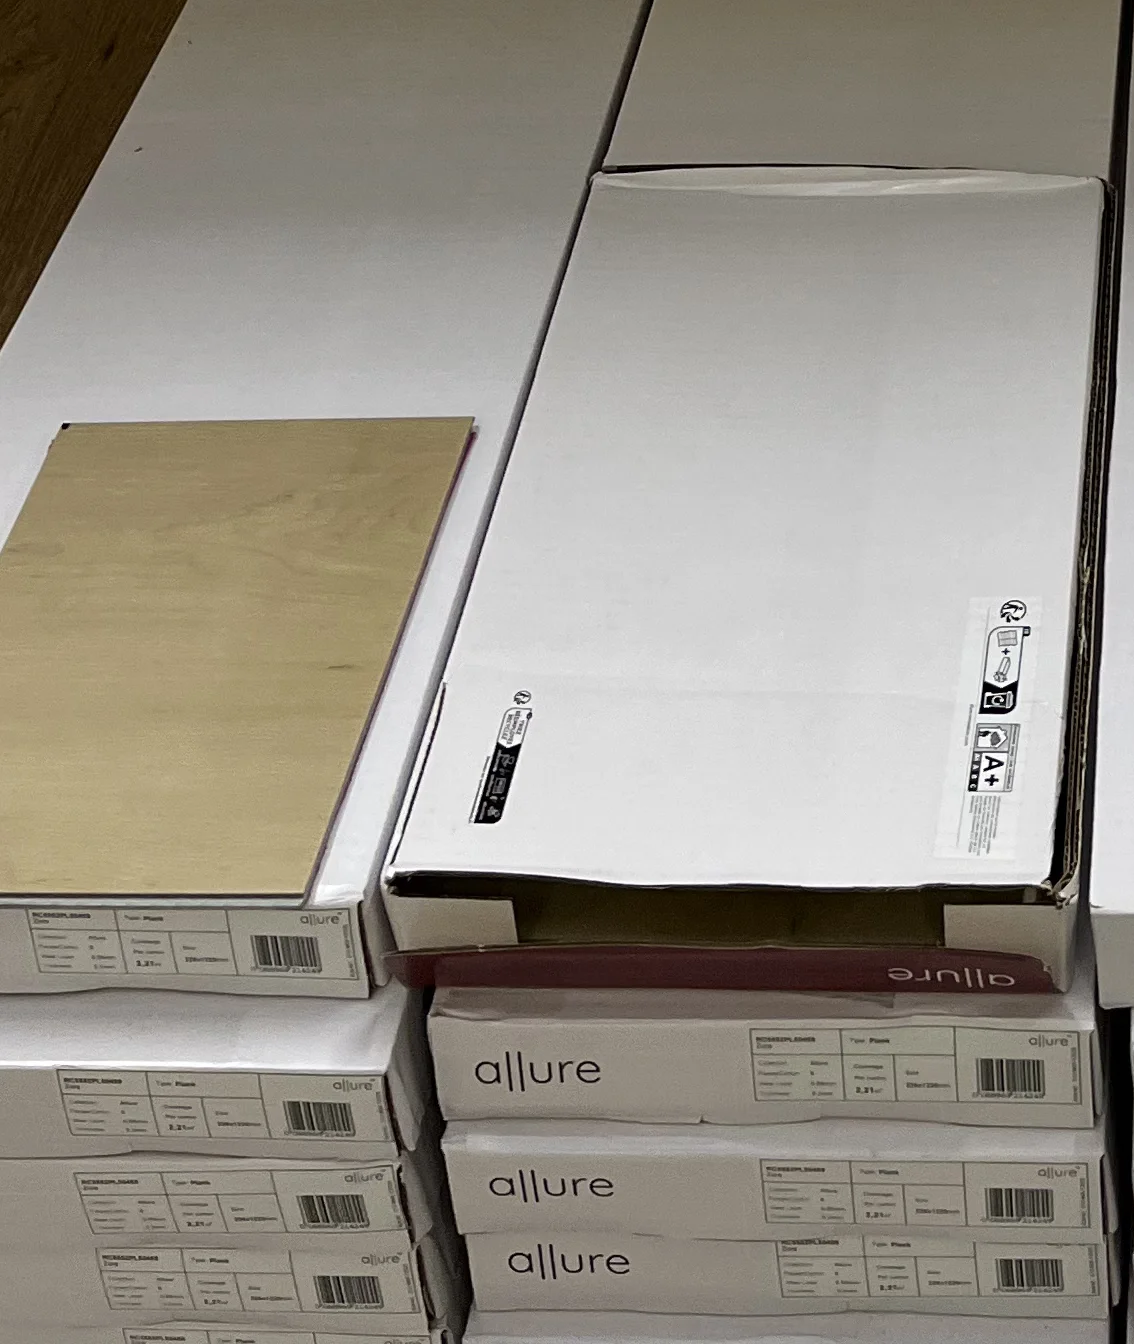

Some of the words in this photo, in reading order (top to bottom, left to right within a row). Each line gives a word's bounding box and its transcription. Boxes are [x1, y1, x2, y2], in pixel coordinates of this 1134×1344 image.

[983, 755, 1005, 787] A+
[300, 914, 340, 926] allure
[887, 965, 1015, 990] allure
[1028, 1034, 1069, 1049] allure
[475, 1051, 602, 1092] allure
[333, 1078, 373, 1092] allure
[344, 1171, 384, 1184] allure
[1037, 1166, 1077, 1181] allure
[488, 1169, 615, 1203] allure
[361, 1253, 400, 1266] allure
[507, 1245, 631, 1280] allure
